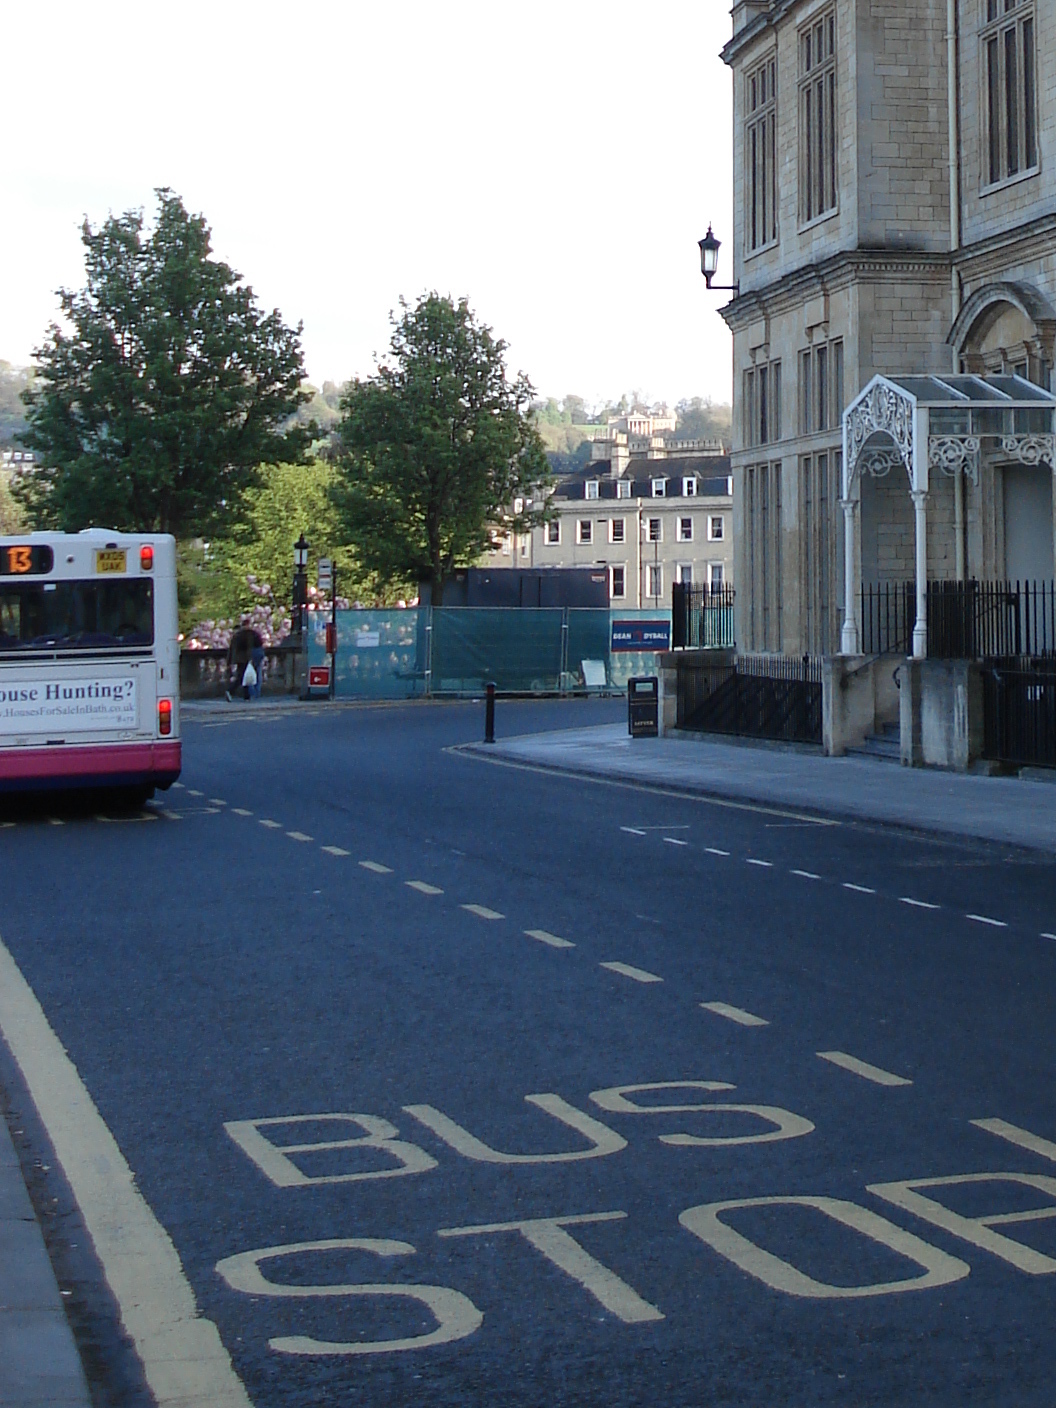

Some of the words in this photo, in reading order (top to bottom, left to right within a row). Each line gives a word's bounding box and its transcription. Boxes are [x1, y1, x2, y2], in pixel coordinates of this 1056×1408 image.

[7, 546, 32, 573] 13
[45, 680, 134, 701] Hunting?
[223, 1080, 815, 1188] BUS
